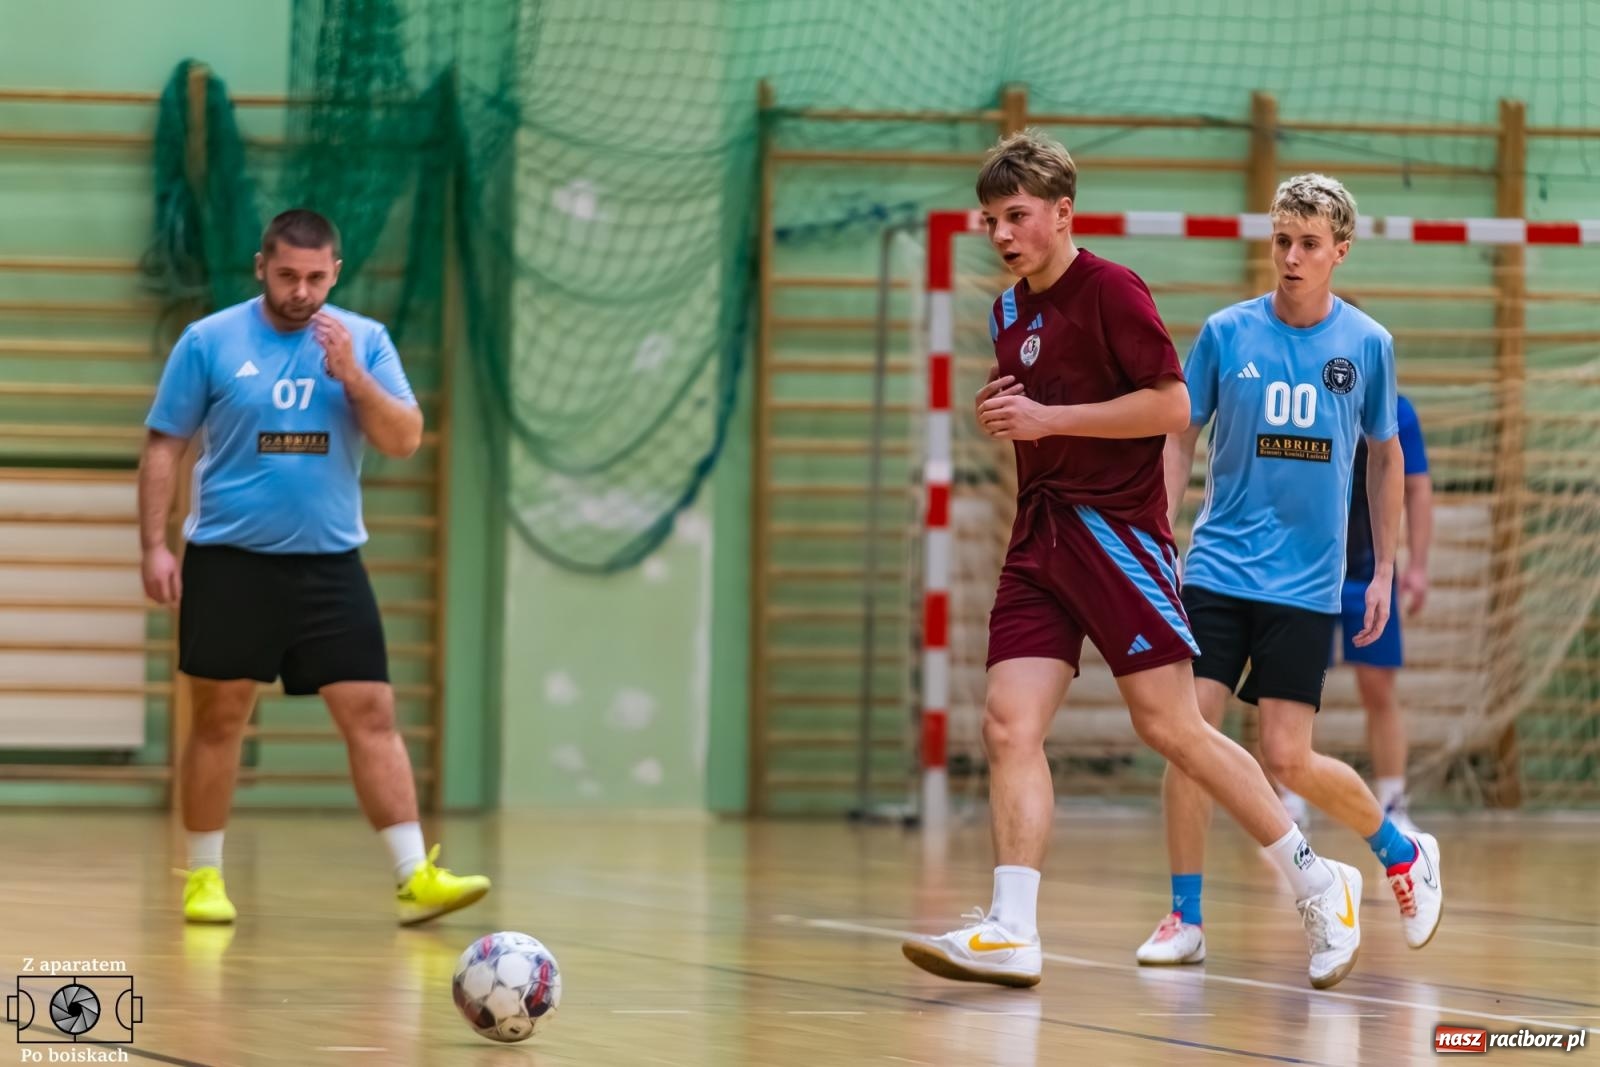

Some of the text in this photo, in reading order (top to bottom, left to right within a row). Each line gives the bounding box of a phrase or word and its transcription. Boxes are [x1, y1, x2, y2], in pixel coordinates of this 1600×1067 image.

[272, 378, 315, 410] 07
[1265, 381, 1317, 428] 00
[1260, 437, 1330, 452] GABRIEL
